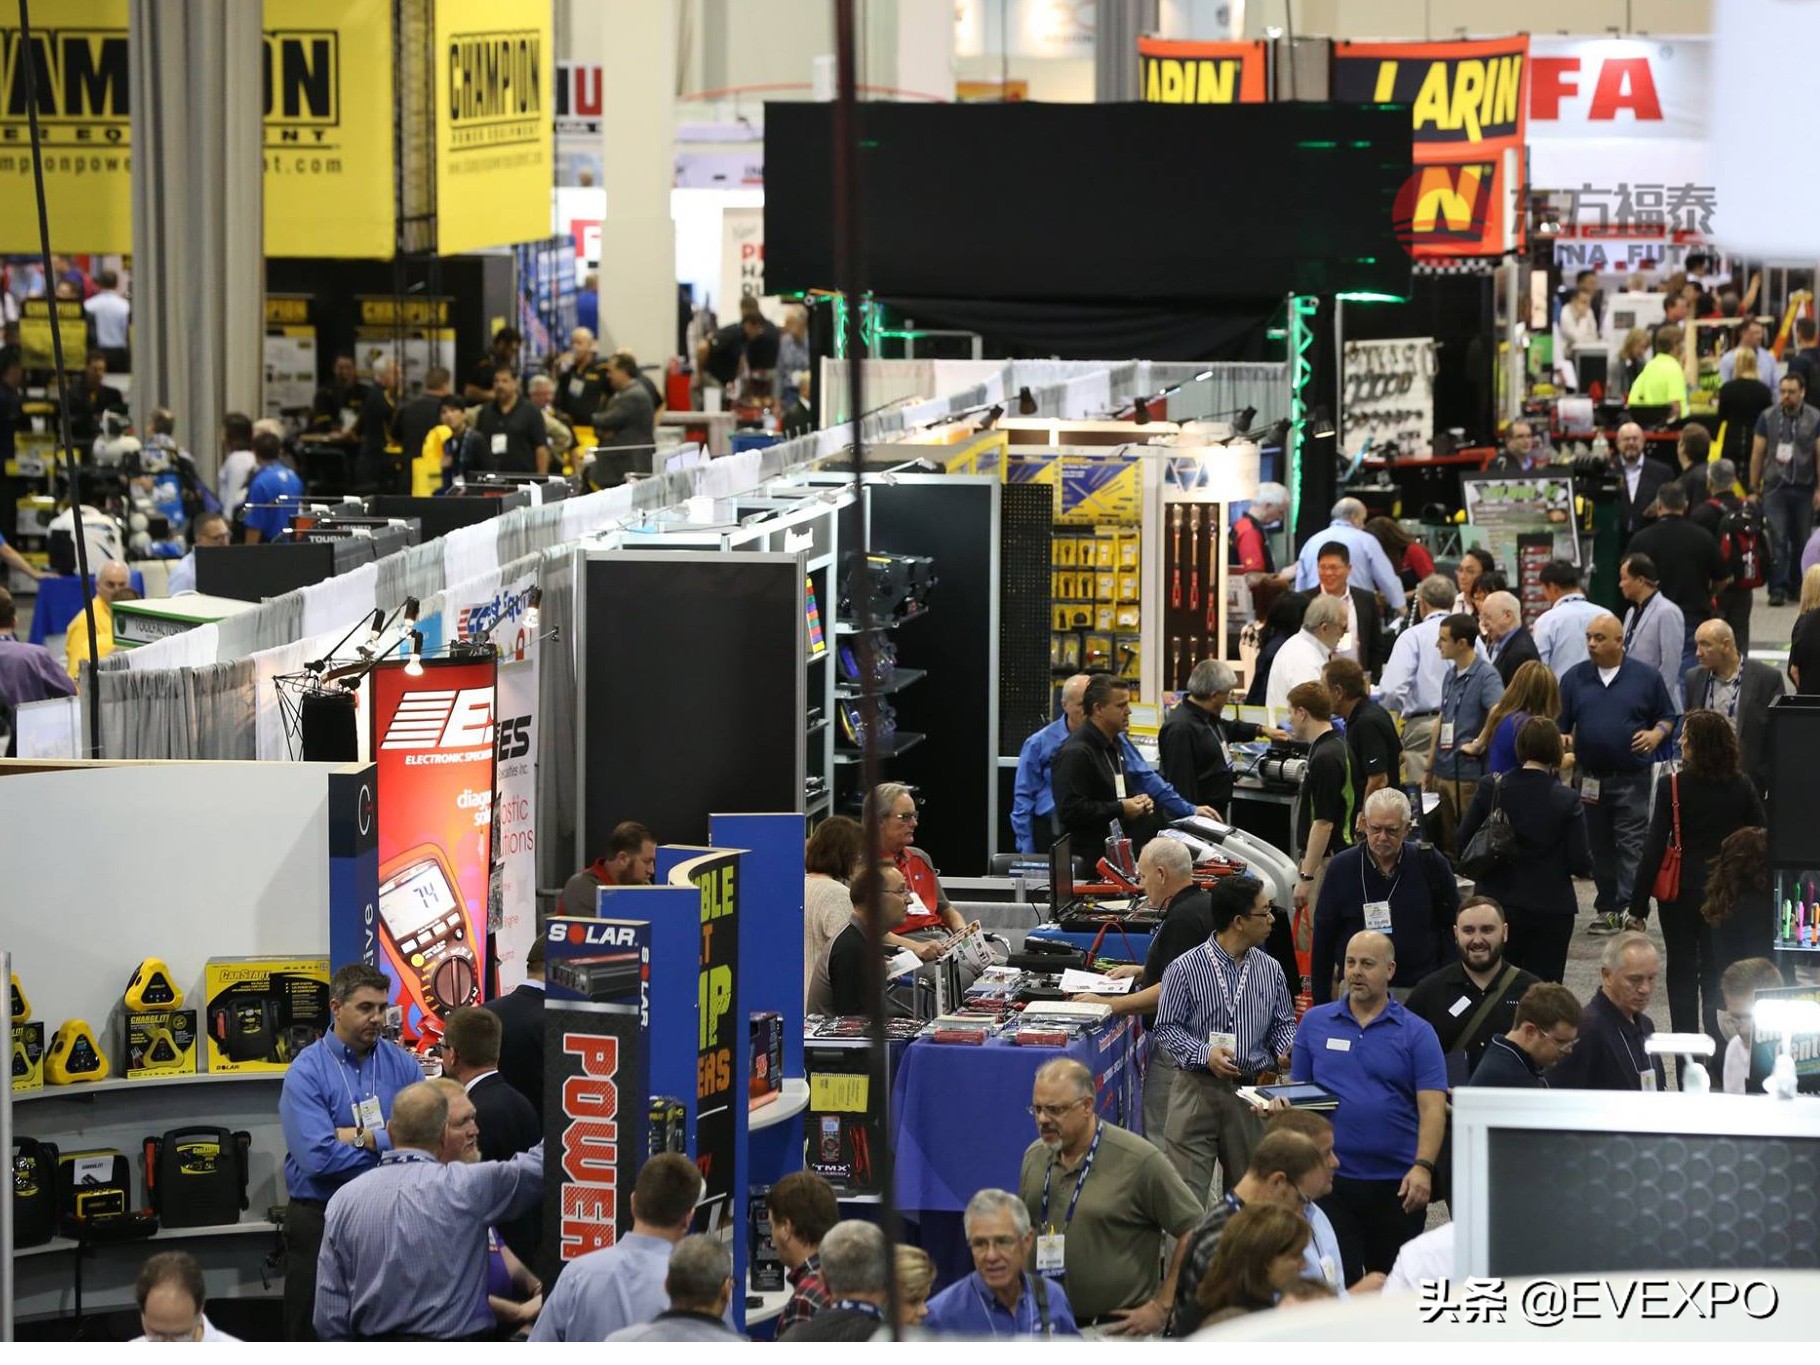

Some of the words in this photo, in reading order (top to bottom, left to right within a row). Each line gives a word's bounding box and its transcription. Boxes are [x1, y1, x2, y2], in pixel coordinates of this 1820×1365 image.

[451, 39, 540, 119] CHAMPION
[1139, 59, 1236, 103] ARIN
[560, 1032, 619, 1262] POWER
